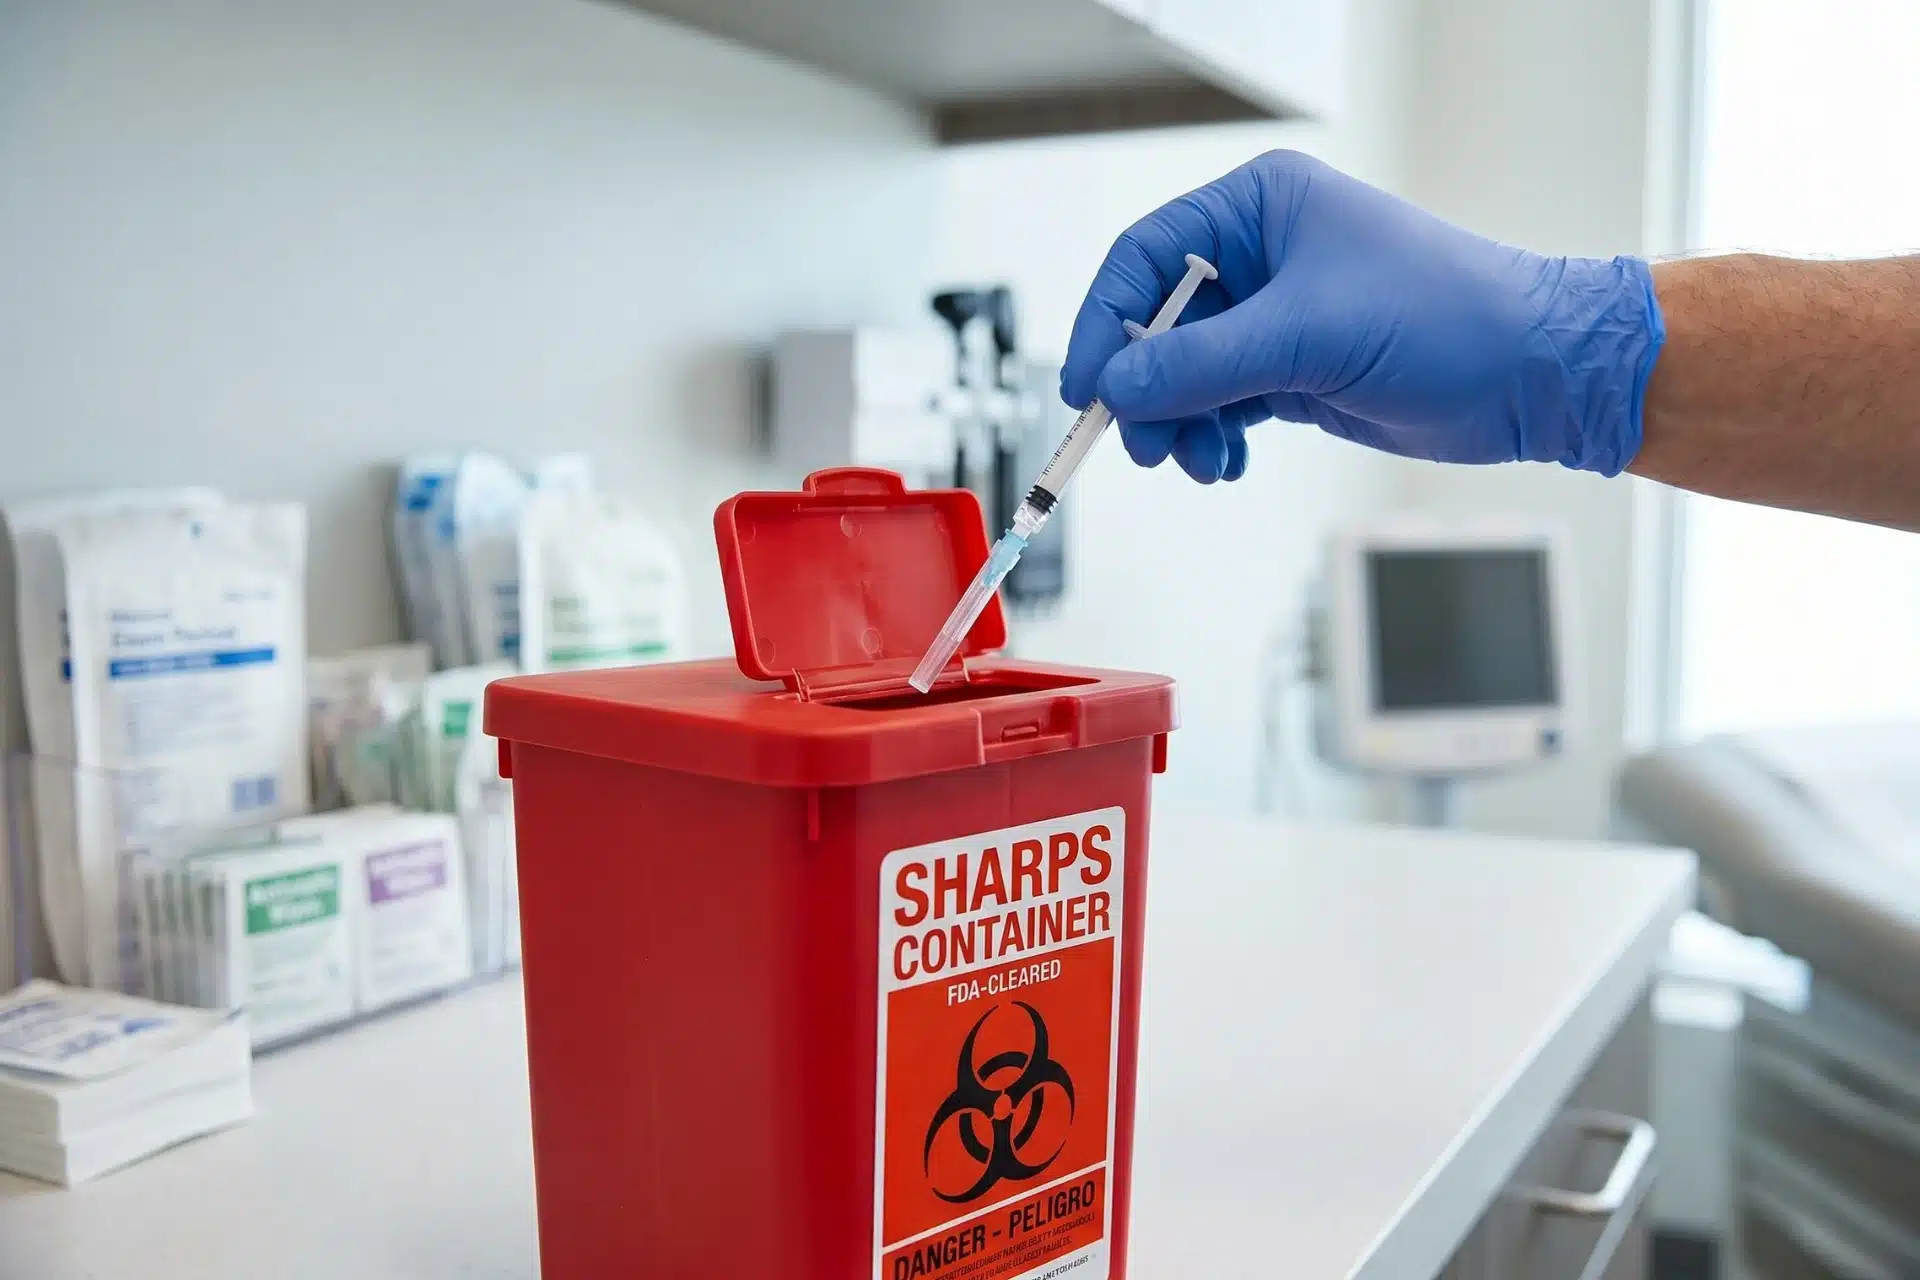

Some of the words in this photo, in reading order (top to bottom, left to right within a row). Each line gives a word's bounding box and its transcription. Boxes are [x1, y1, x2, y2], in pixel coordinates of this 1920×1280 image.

[894, 825, 1112, 927] SHARPS
[893, 891, 1110, 980] CONTAINER
[948, 959, 1061, 1006] FDA-CLEARED
[894, 1224, 986, 1280] DANGER
[1008, 1180, 1095, 1239] PELIGRO
